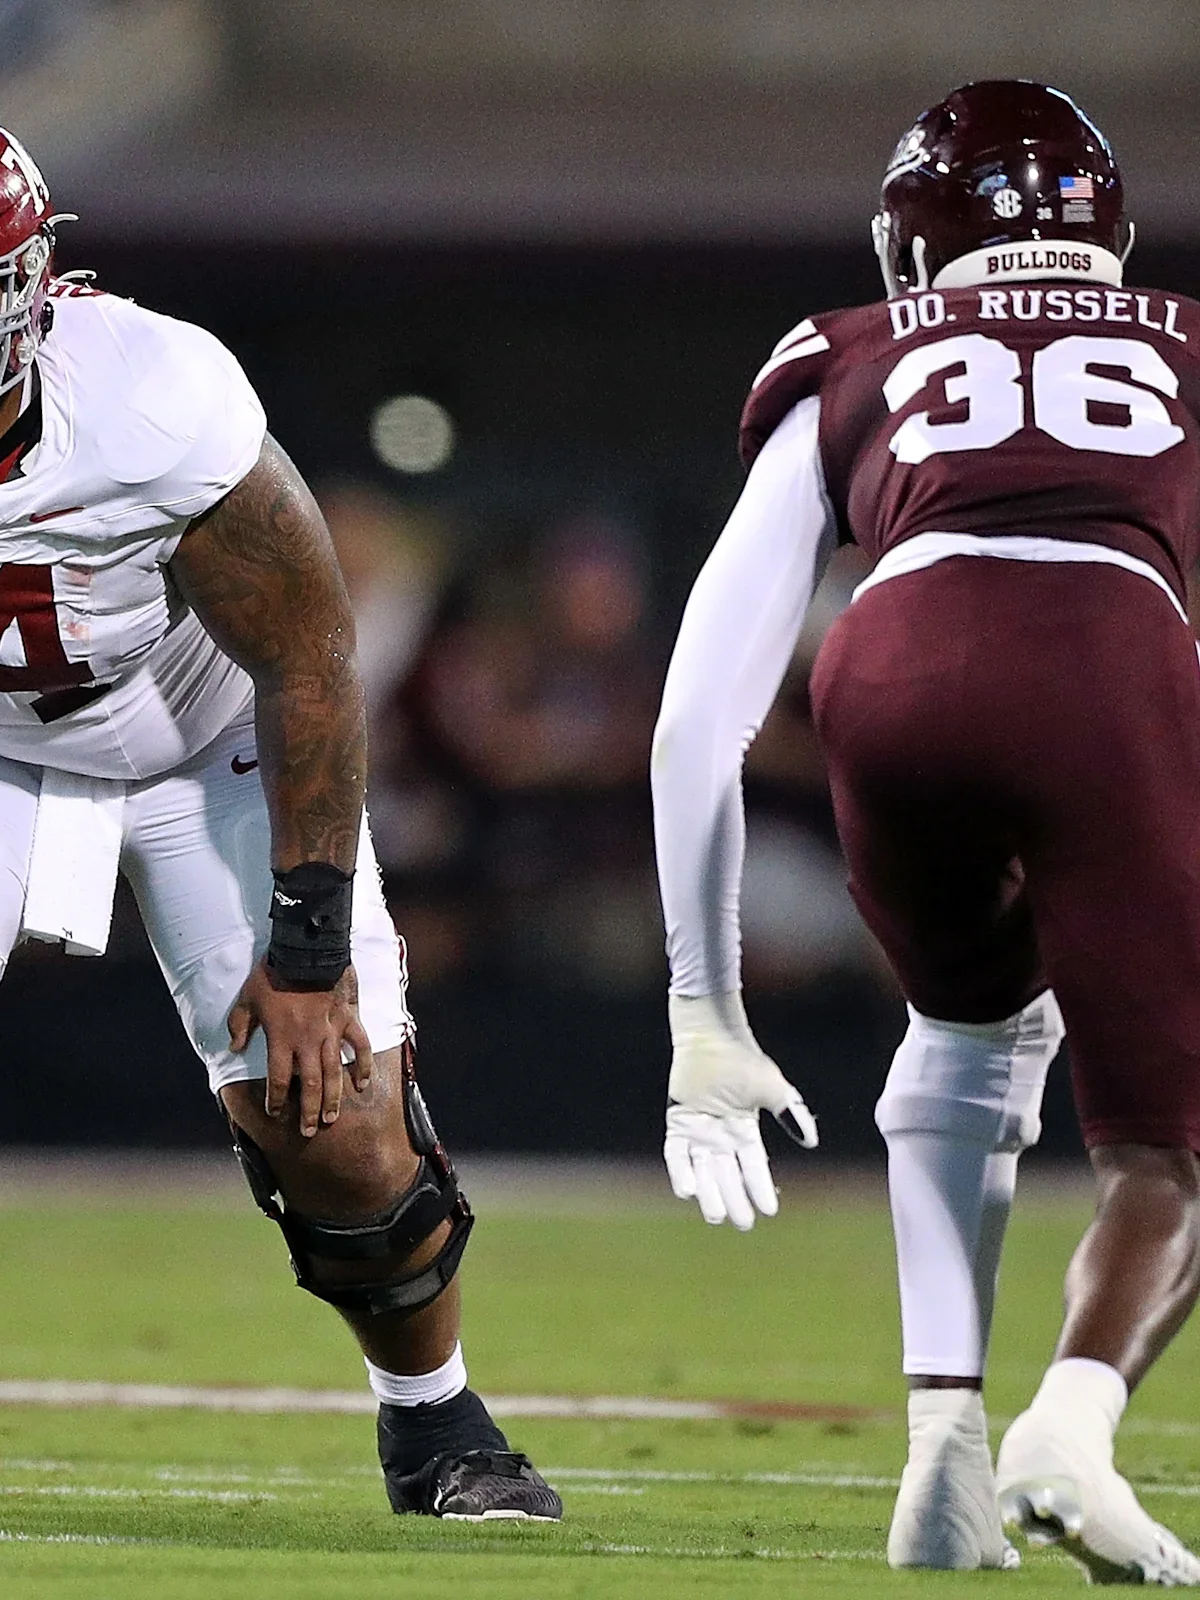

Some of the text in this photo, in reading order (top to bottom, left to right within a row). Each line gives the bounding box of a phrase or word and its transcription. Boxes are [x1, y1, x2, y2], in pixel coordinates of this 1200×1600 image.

[986, 250, 1092, 275] BULLDOGS
[887, 289, 1188, 343] DO. RUSSELL
[882, 332, 1186, 465] 36
